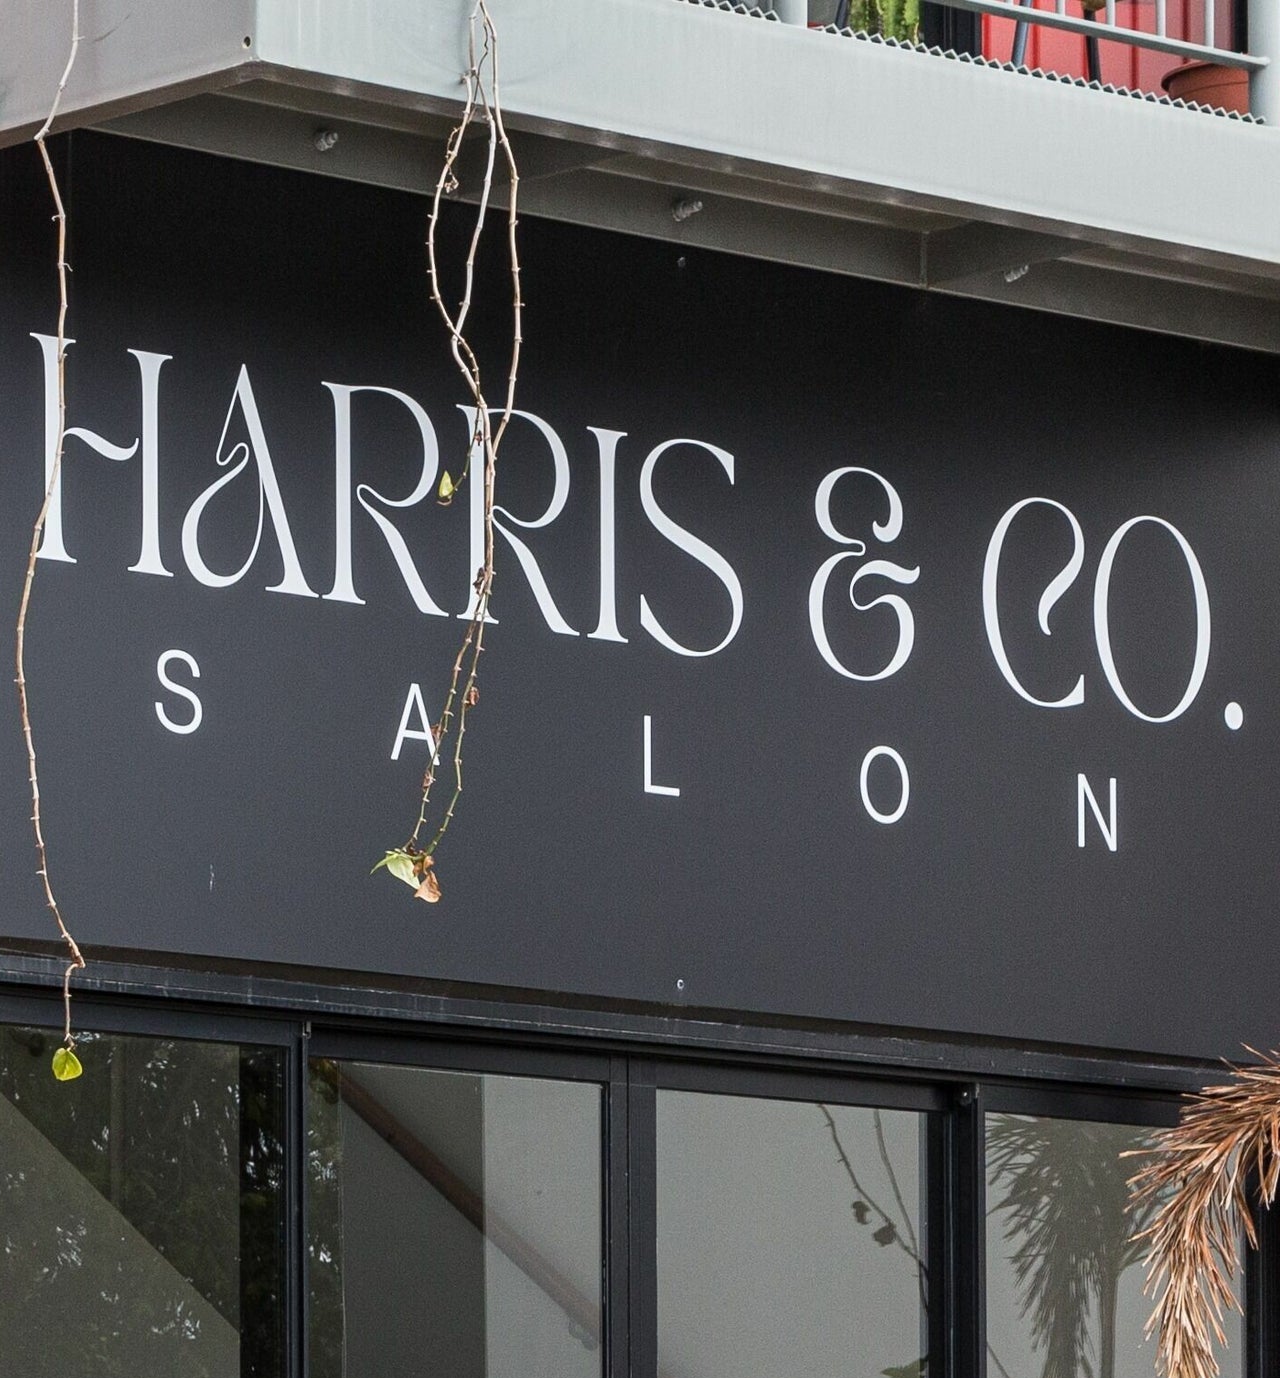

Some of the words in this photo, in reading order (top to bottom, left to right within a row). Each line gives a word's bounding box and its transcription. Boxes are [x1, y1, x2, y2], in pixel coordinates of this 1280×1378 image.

[30, 332, 744, 658] HARRIS
[809, 467, 920, 681] &
[983, 498, 1244, 730] CO.
[154, 648, 1118, 852] SALON
